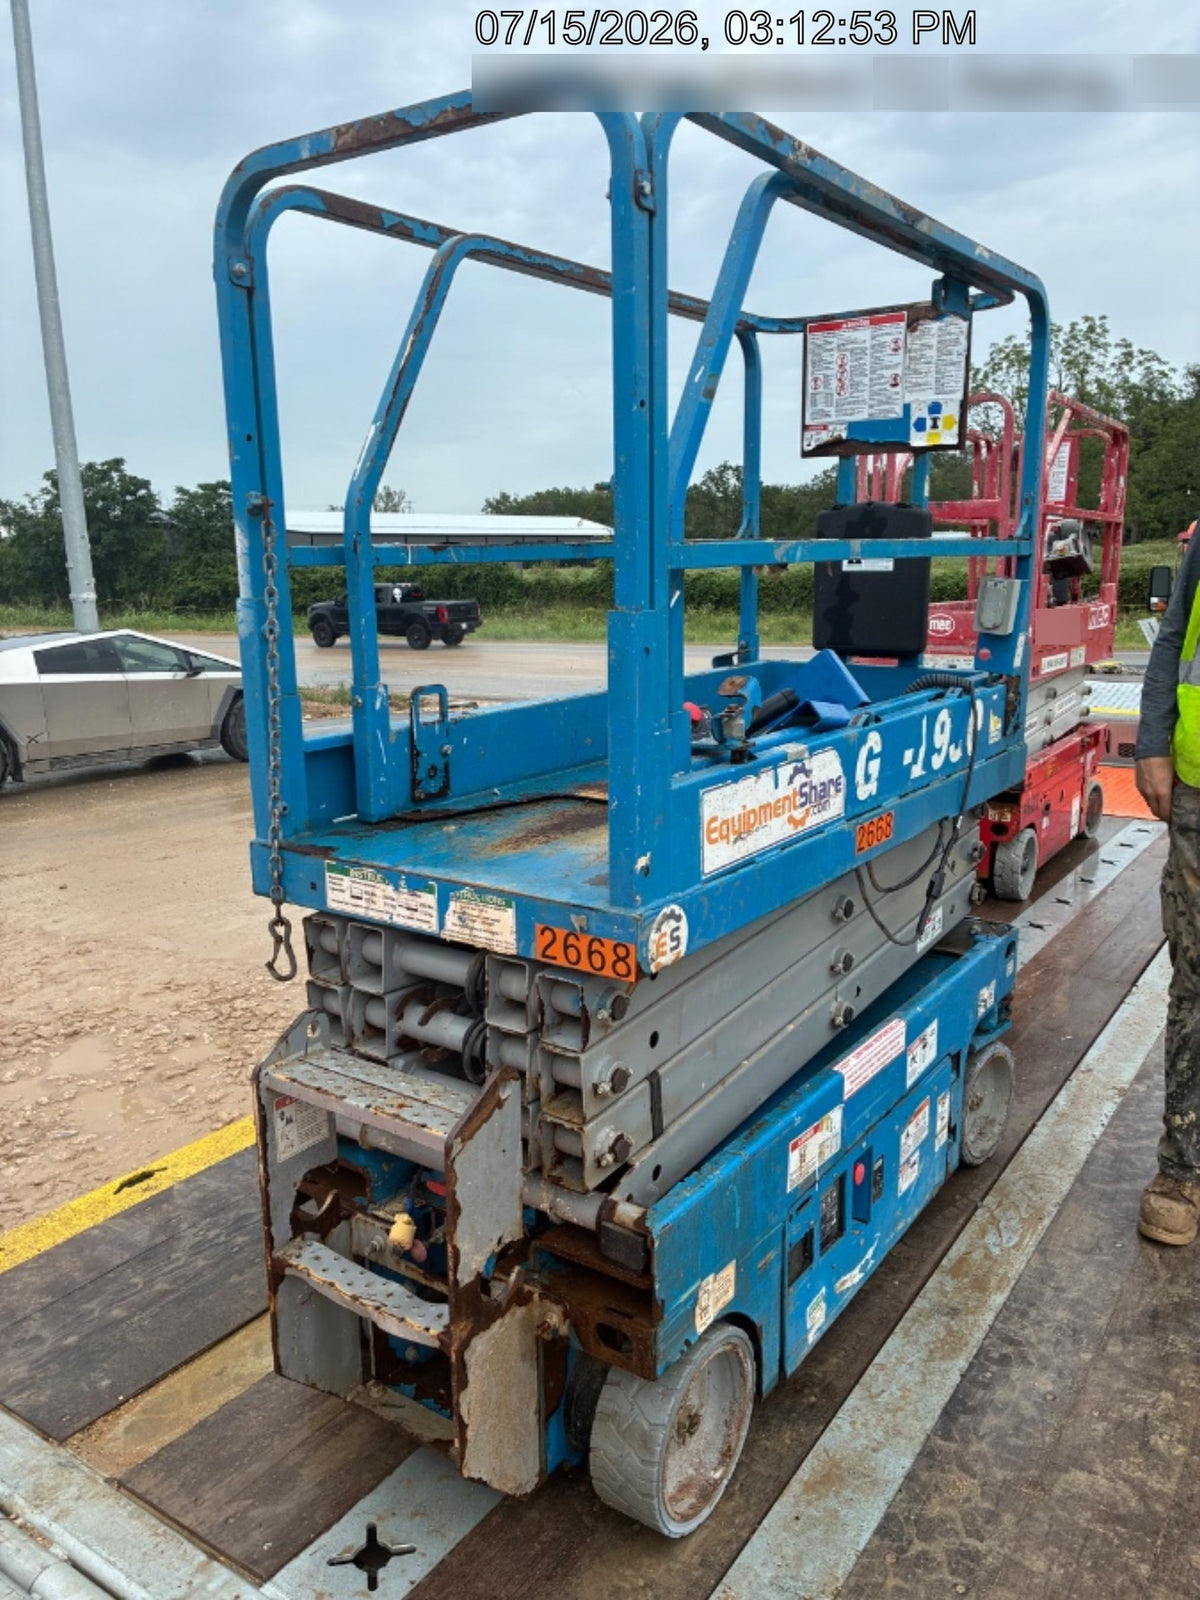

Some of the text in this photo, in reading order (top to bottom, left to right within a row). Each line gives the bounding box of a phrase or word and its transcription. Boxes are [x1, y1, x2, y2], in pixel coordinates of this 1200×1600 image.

[705, 773, 842, 845] EquipmentShare
[856, 813, 893, 852] 2668
[540, 925, 632, 979] 2668
[655, 926, 682, 957] ES
